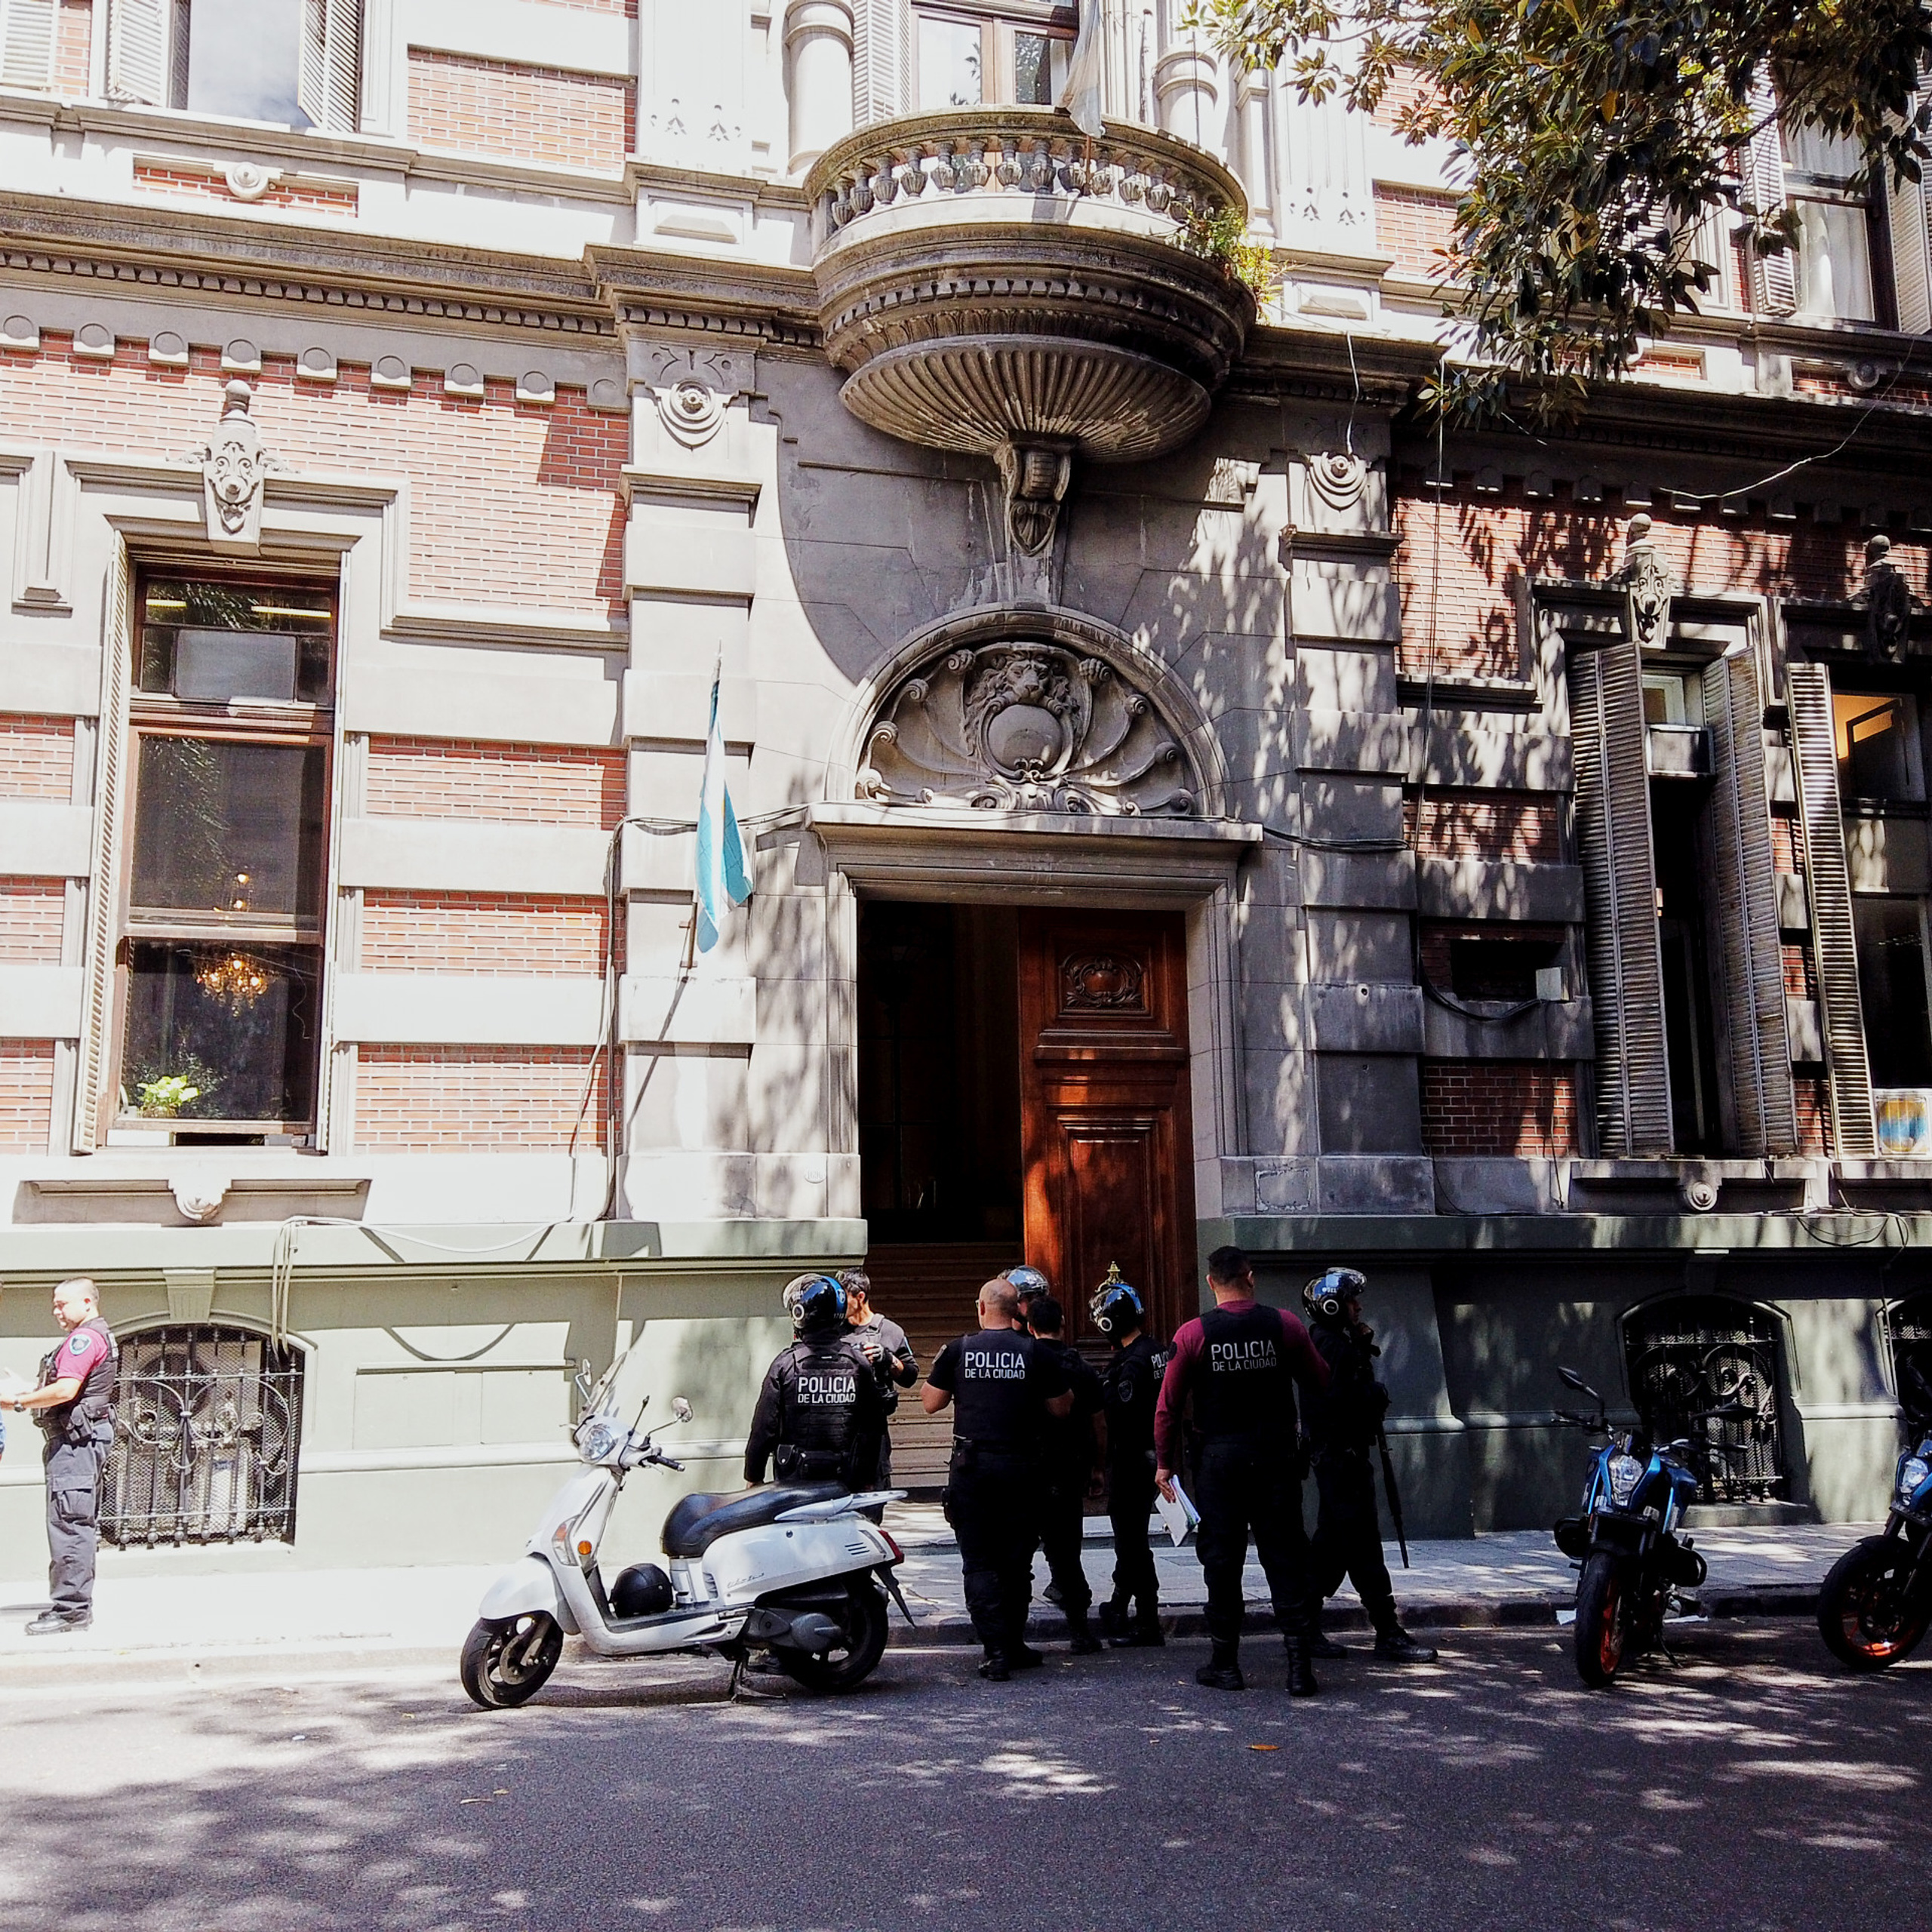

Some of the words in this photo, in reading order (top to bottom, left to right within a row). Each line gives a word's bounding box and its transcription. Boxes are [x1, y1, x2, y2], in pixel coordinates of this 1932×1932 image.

[1211, 1340, 1276, 1361] POLICIA
[964, 1351, 1026, 1369] POLICIA
[1212, 1361, 1226, 1372] DE
[1228, 1360, 1241, 1371] LA
[1243, 1357, 1277, 1370] CIUDAD
[964, 1368, 977, 1379] DE
[979, 1368, 991, 1379] LA
[992, 1368, 1026, 1380] CIUDAD
[798, 1376, 857, 1393] POLICIA
[797, 1393, 811, 1404] DE
[811, 1393, 824, 1404] LA
[826, 1392, 857, 1404] CIUDAD
